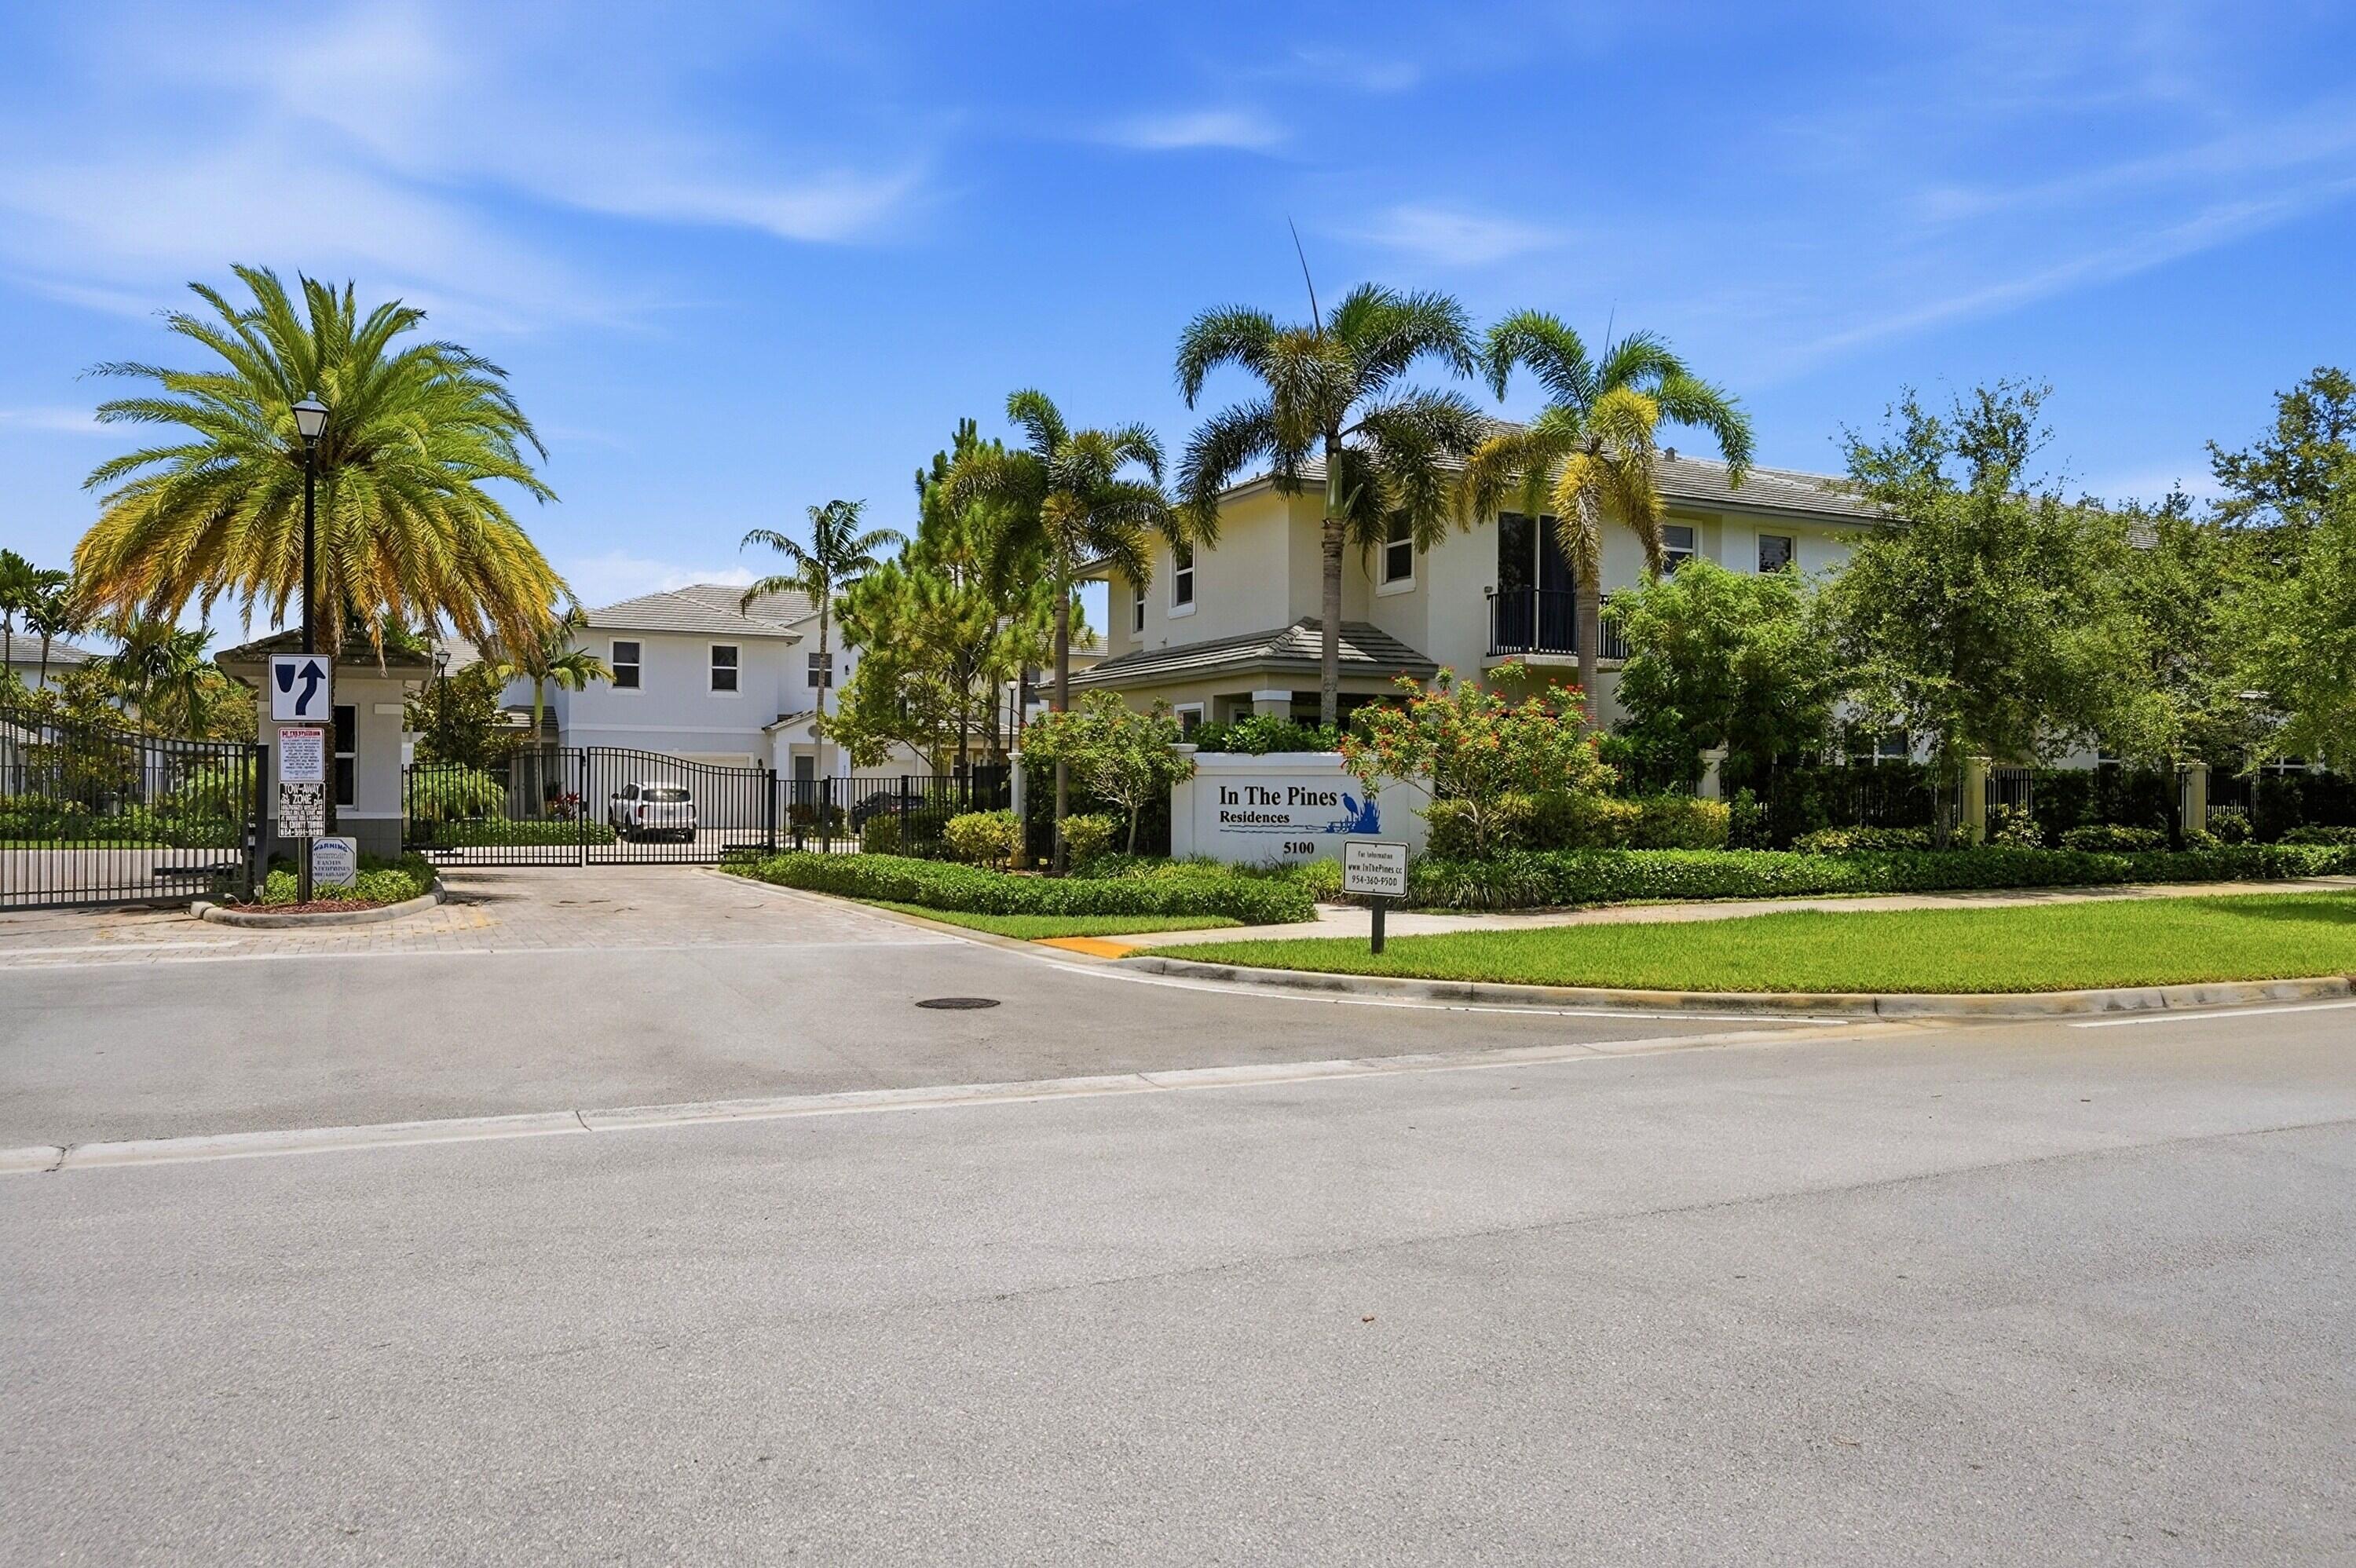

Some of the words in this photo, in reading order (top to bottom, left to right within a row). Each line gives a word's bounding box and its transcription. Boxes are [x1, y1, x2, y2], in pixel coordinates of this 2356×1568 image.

[284, 784, 320, 794] TOW-AWAY
[292, 794, 312, 805] ZONE
[1220, 786, 1238, 805] In
[1245, 787, 1281, 806] The
[1287, 787, 1337, 806] Pines
[1220, 810, 1290, 824] Residences
[313, 842, 348, 853] WARNING
[1283, 841, 1315, 854] 5100
